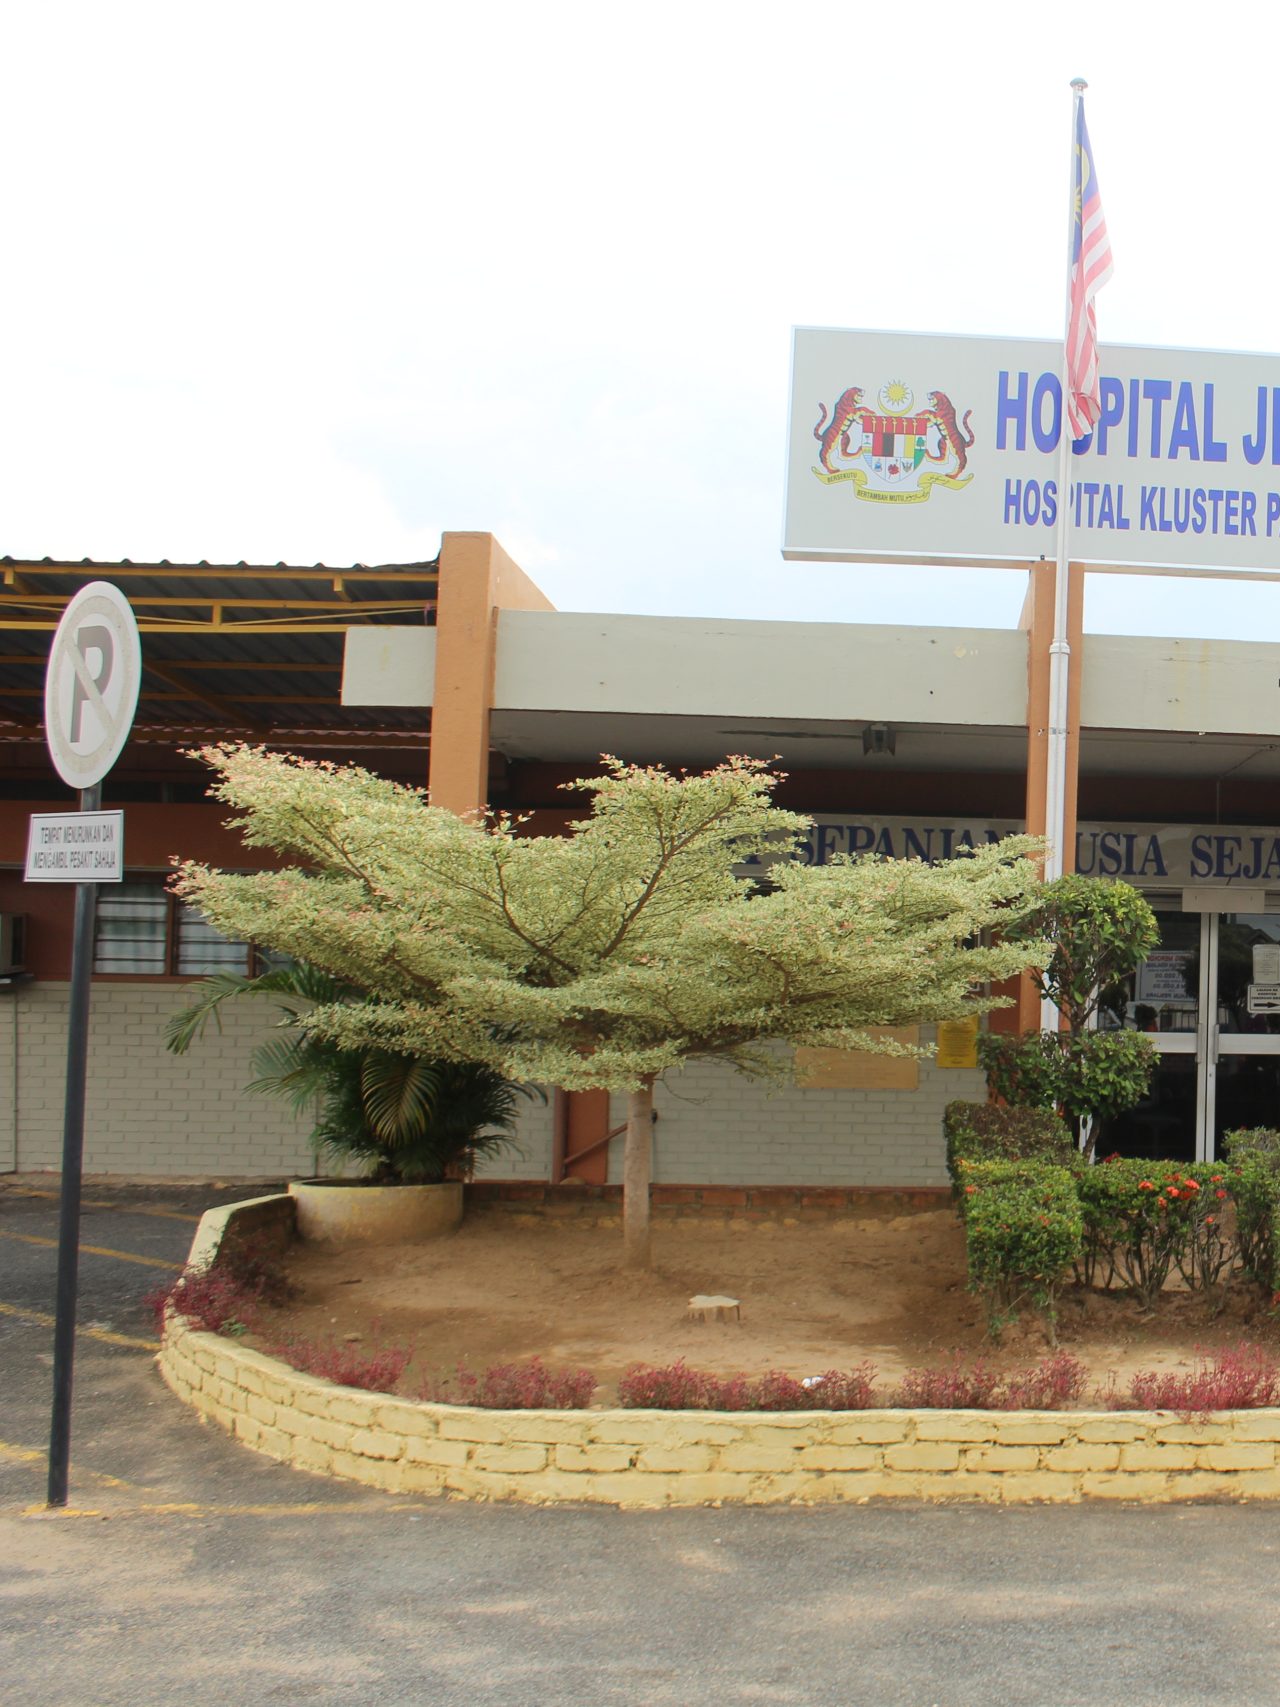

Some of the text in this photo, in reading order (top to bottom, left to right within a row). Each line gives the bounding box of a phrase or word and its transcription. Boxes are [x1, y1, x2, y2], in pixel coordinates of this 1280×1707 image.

[996, 371, 1227, 462] HOPITAL
[827, 472, 857, 483] BERSEKUTU
[856, 489, 888, 501] BERTAMBAH
[889, 493, 904, 502] MUTU
[1004, 478, 1130, 530] HOSITAL
[1140, 486, 1257, 536] KLUSTER
[70, 625, 114, 743] P
[41, 824, 114, 844] TEMPAT MENURUNKAN DAN
[34, 850, 116, 868] MENGAMBIL PESAKIT SAHAJA
[1075, 831, 1168, 877] USIA
